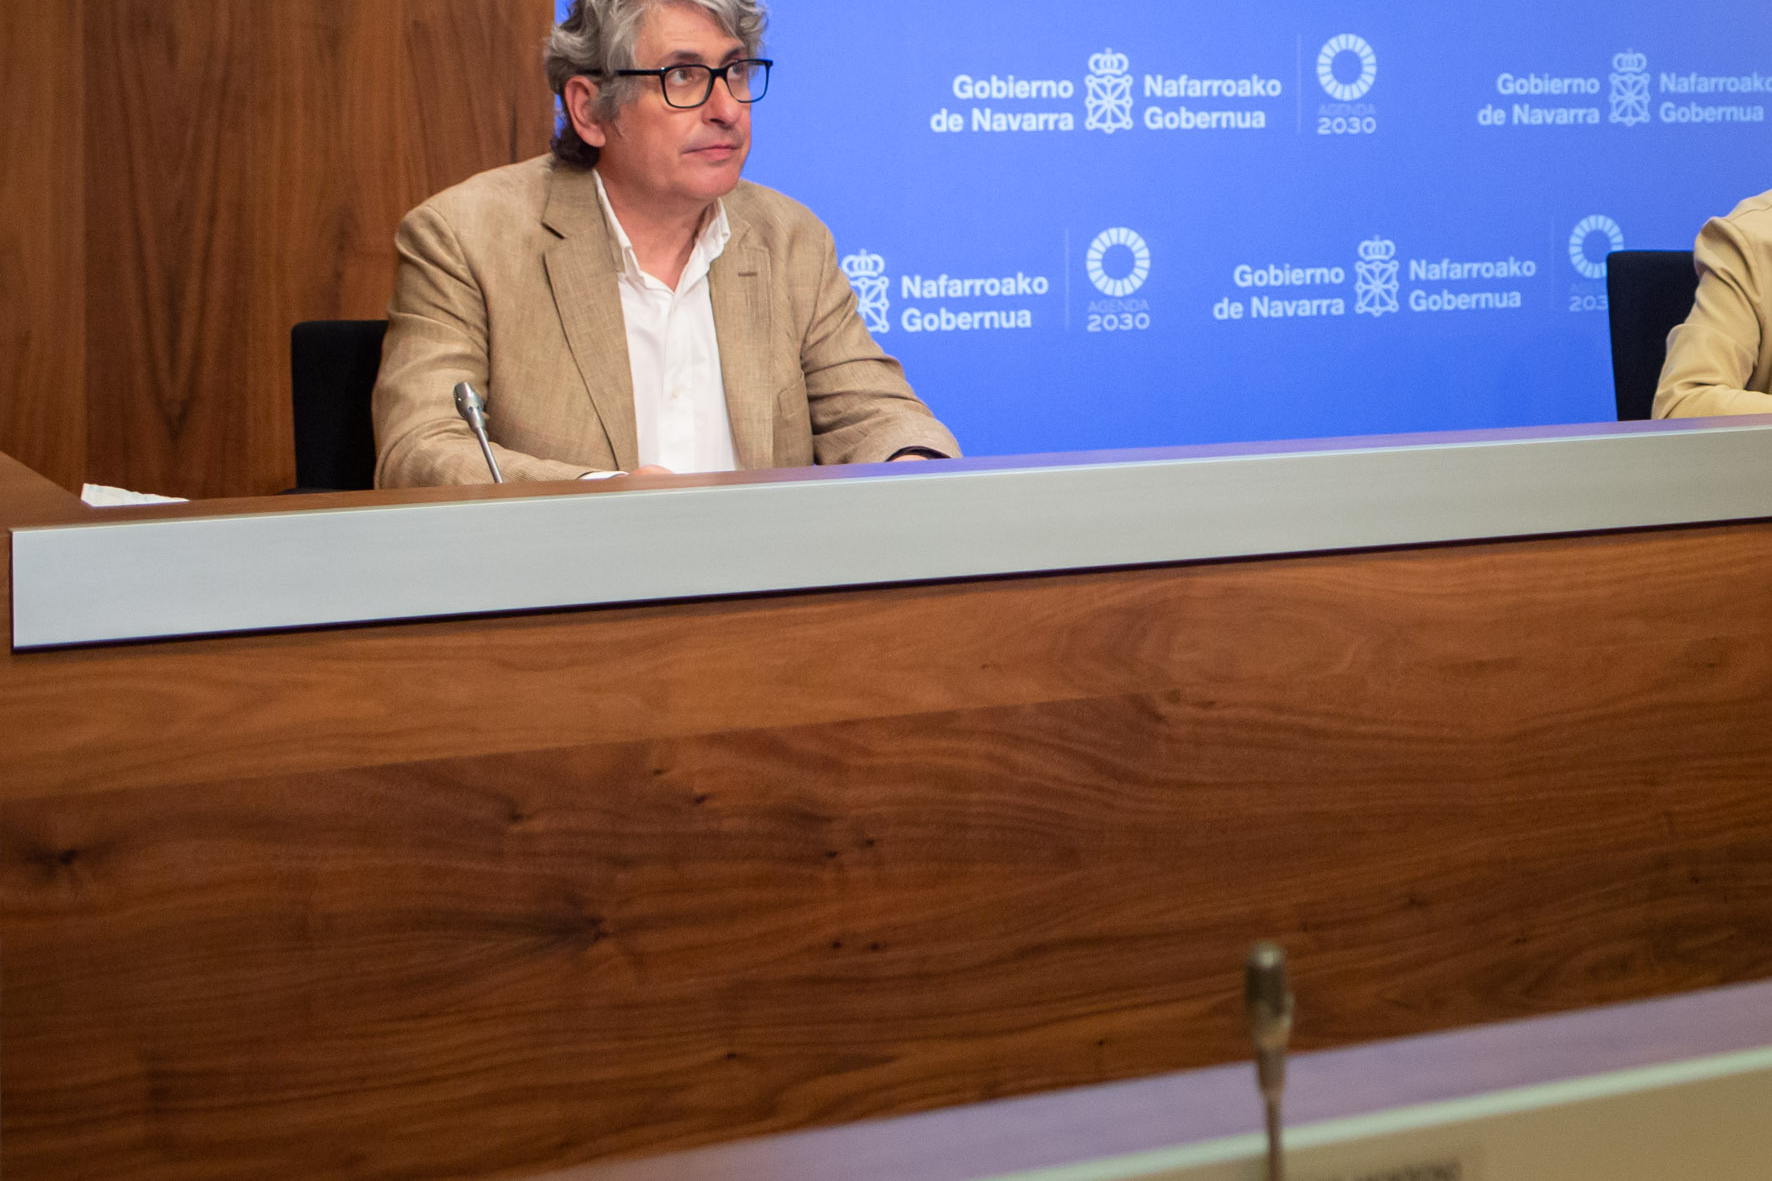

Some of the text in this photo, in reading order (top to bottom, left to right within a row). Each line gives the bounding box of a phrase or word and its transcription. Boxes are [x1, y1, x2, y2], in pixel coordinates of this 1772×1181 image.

[953, 74, 1074, 101] Gobierno
[1144, 74, 1282, 99] Nafarroako
[1497, 72, 1599, 96] Gobierno
[930, 109, 1075, 133] de Navarra
[1144, 106, 1266, 130] Gobernua
[1477, 103, 1600, 126] de Navarra
[1660, 102, 1764, 123] Gobernua
[1317, 116, 1377, 135] 2030
[1233, 264, 1345, 288] Gobierno
[1409, 256, 1536, 282] Nafarroako
[901, 272, 1048, 300] Nafarroako
[1213, 295, 1345, 320] de Navarra
[1409, 288, 1521, 312] Gobernua
[1569, 295, 1608, 312] 203
[902, 307, 1032, 333] Gobernua
[1086, 312, 1150, 333] 2030
